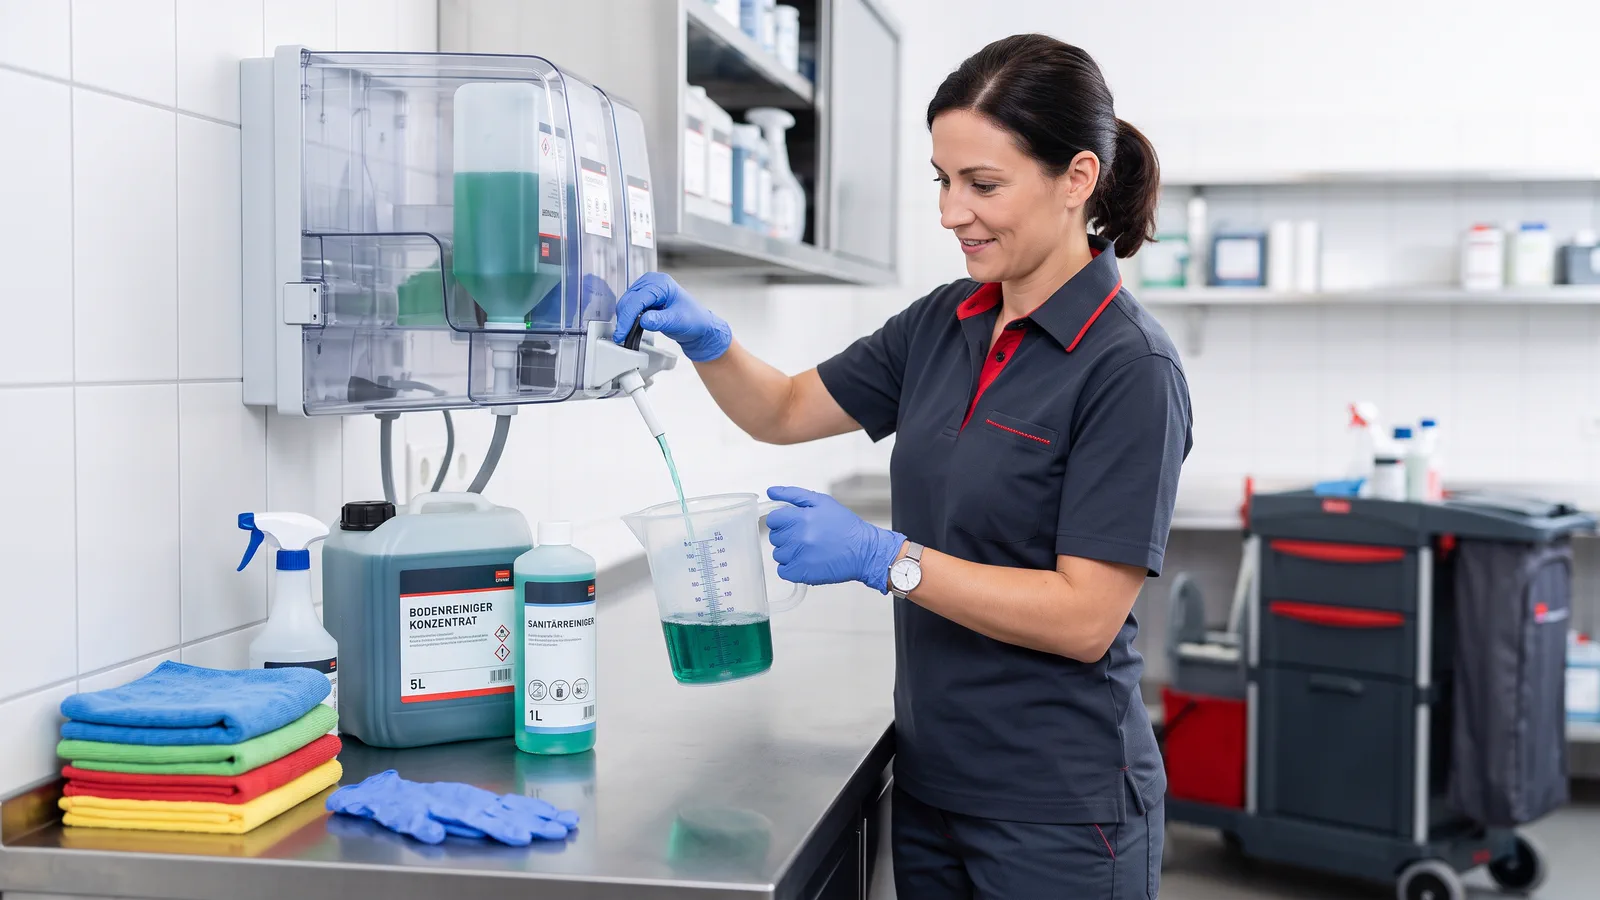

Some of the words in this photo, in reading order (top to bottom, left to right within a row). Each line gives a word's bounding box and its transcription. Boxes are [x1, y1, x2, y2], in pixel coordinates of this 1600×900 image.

[409, 602, 493, 617] BODENREINIGER
[409, 616, 478, 630] KONZENTRAT
[527, 617, 595, 629] SANITÄRREINIGER
[410, 678, 426, 690] 5L
[529, 709, 543, 722] 1L
